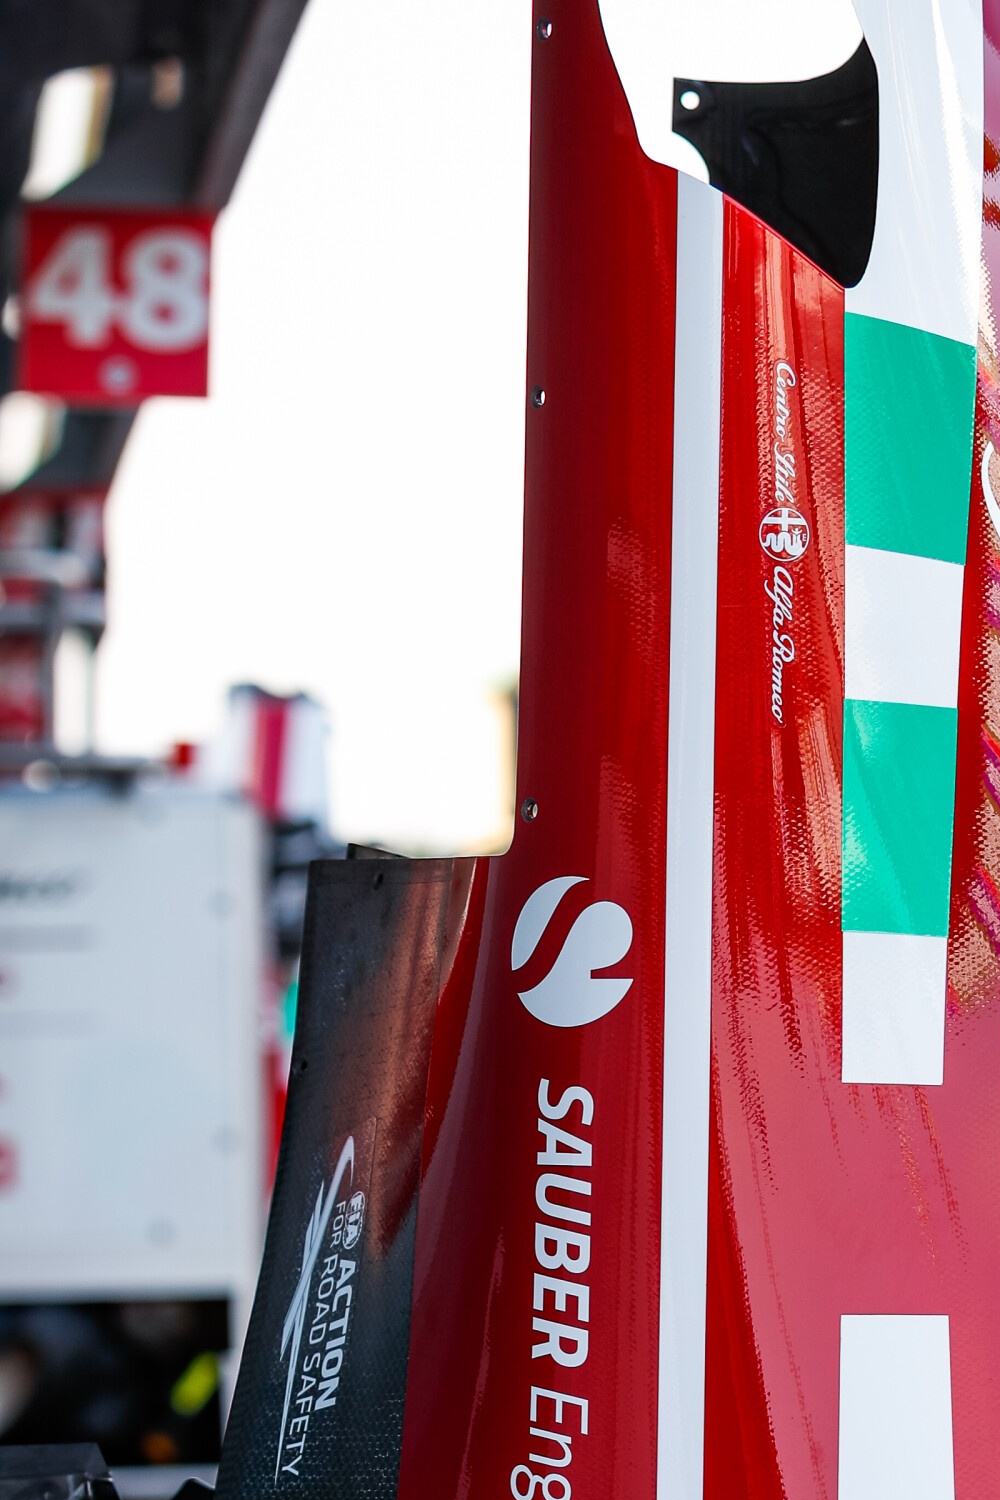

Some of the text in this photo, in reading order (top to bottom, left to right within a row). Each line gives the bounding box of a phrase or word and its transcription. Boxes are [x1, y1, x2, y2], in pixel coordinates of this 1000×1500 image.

[27, 225, 209, 352] 48
[772, 361, 796, 446] Centro
[763, 565, 795, 726] Alfa Romeo
[314, 1191, 364, 1411] FIA ACTION
[531, 1077, 595, 1369] SAUBER
[281, 1200, 346, 1476] FOR ROAD SAFETY
